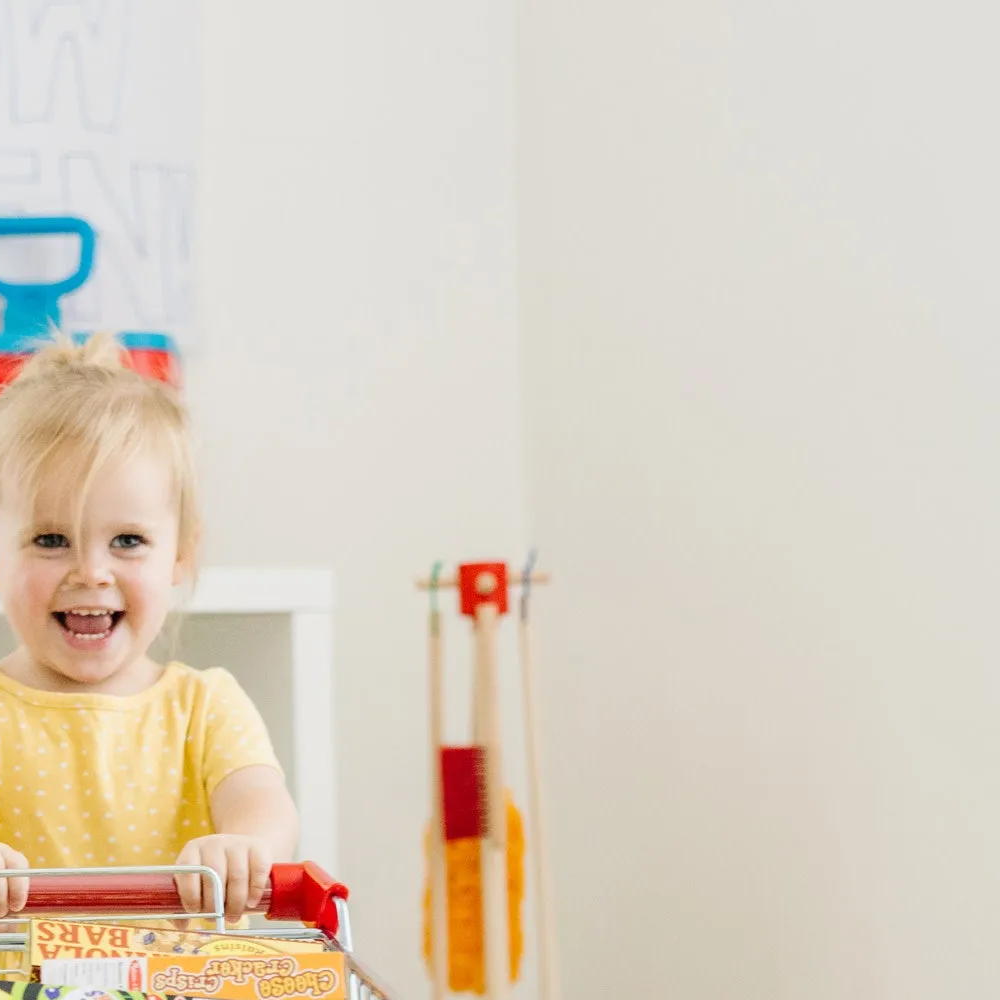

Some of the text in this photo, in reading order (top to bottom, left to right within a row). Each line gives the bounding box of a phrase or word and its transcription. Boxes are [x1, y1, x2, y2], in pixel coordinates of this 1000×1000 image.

[37, 921, 129, 949] BARS
[207, 958, 296, 986] Cracker
[258, 969, 336, 999] Cheese
